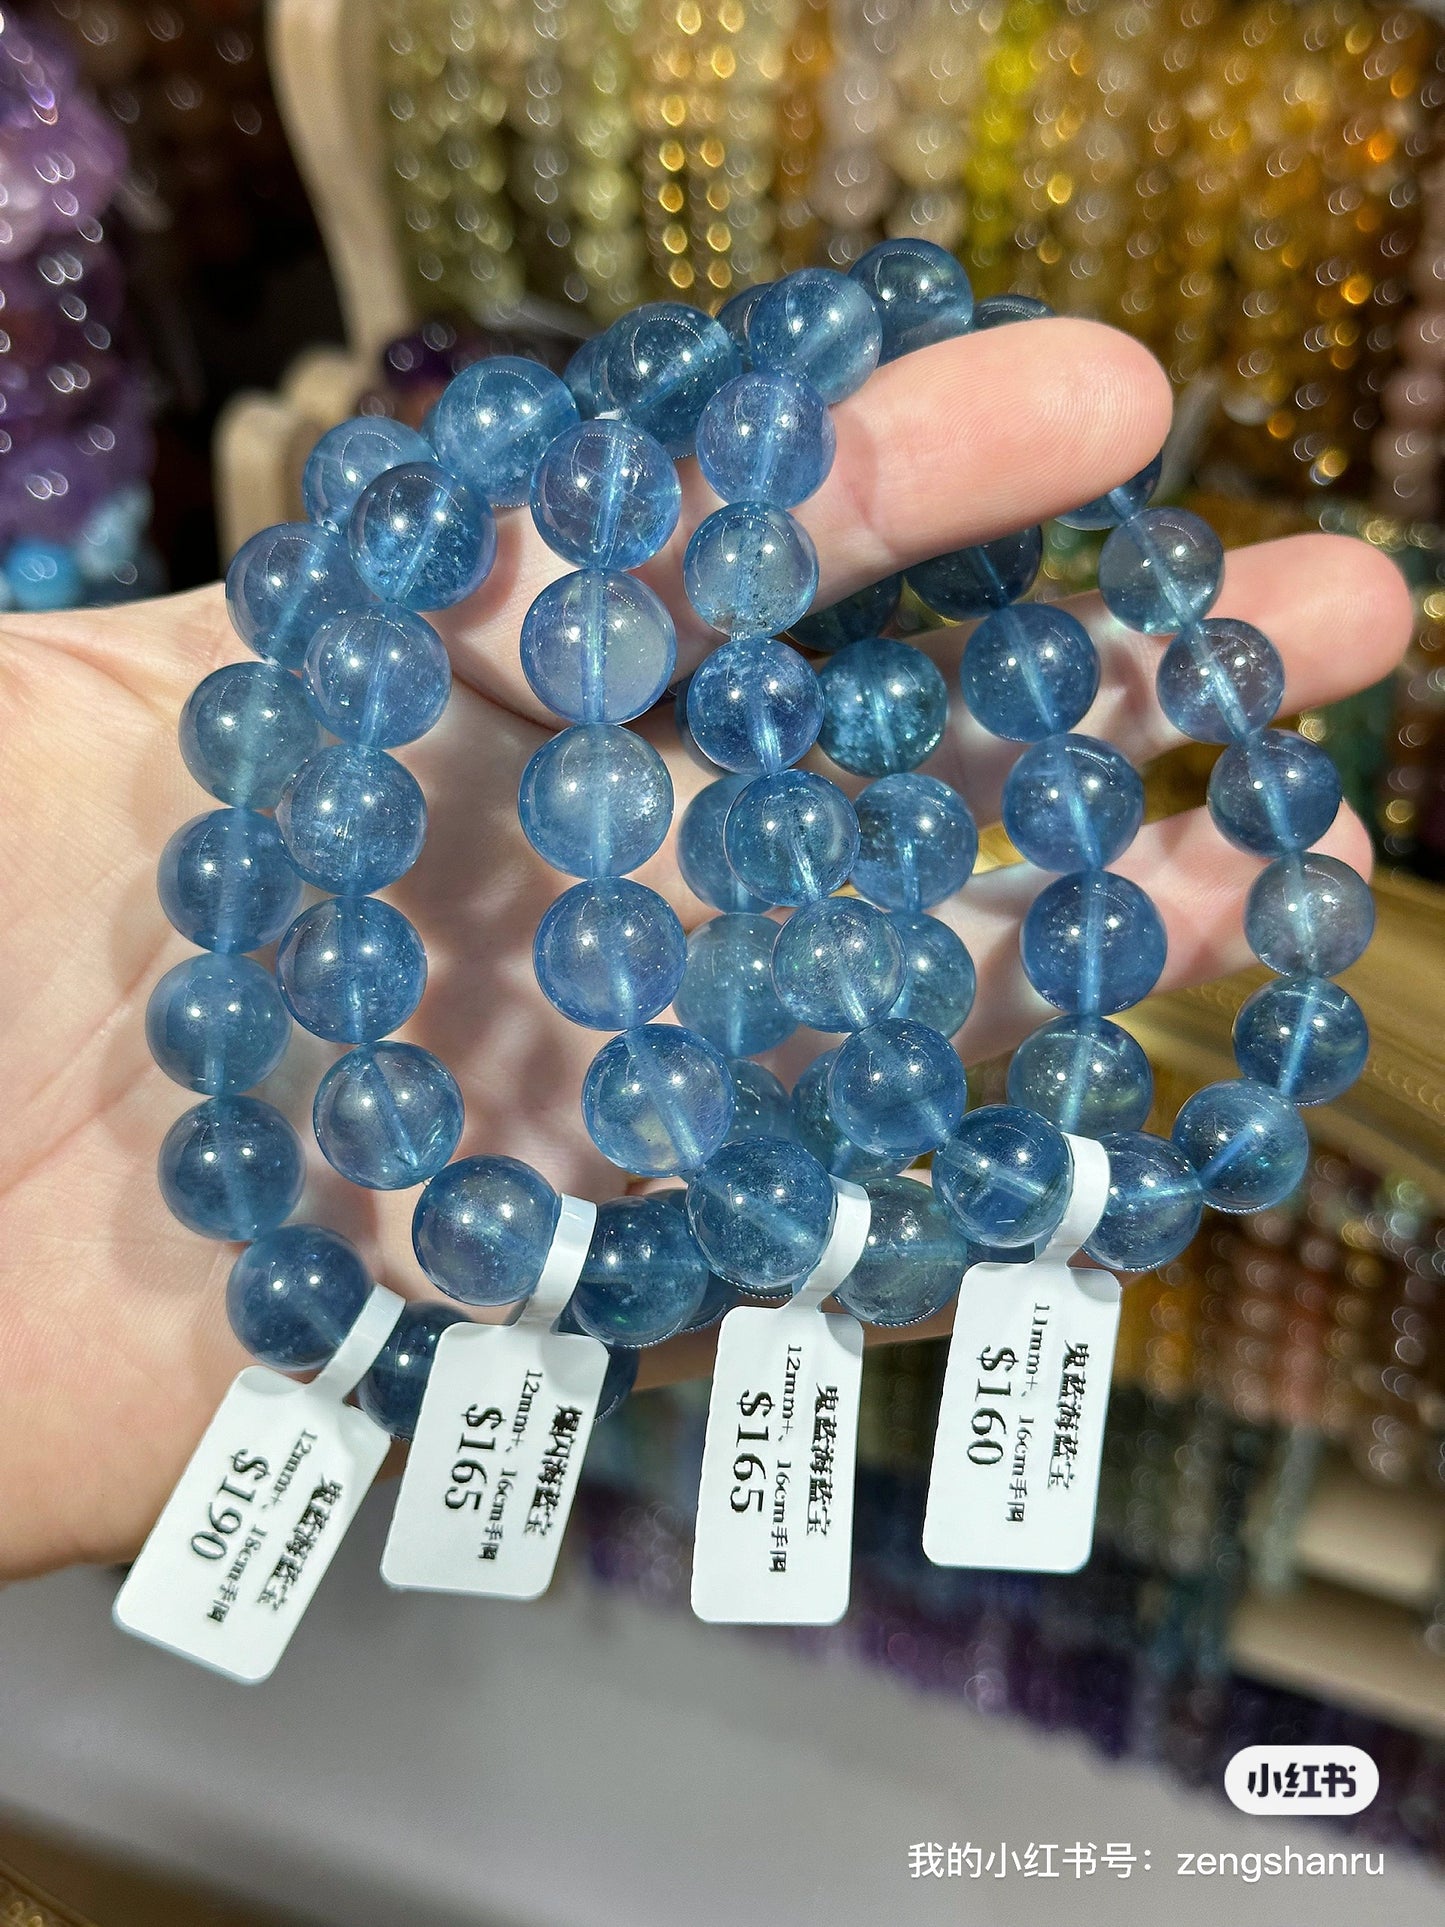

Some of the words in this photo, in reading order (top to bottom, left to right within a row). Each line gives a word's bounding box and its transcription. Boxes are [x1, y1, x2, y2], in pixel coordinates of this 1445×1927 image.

[444, 1403, 507, 1511] $165
[729, 1388, 776, 1514] $165
[806, 1382, 840, 1537] 鬼蓝海蓝宝
[966, 1344, 1020, 1466] $160
[189, 1448, 271, 1571] $190
